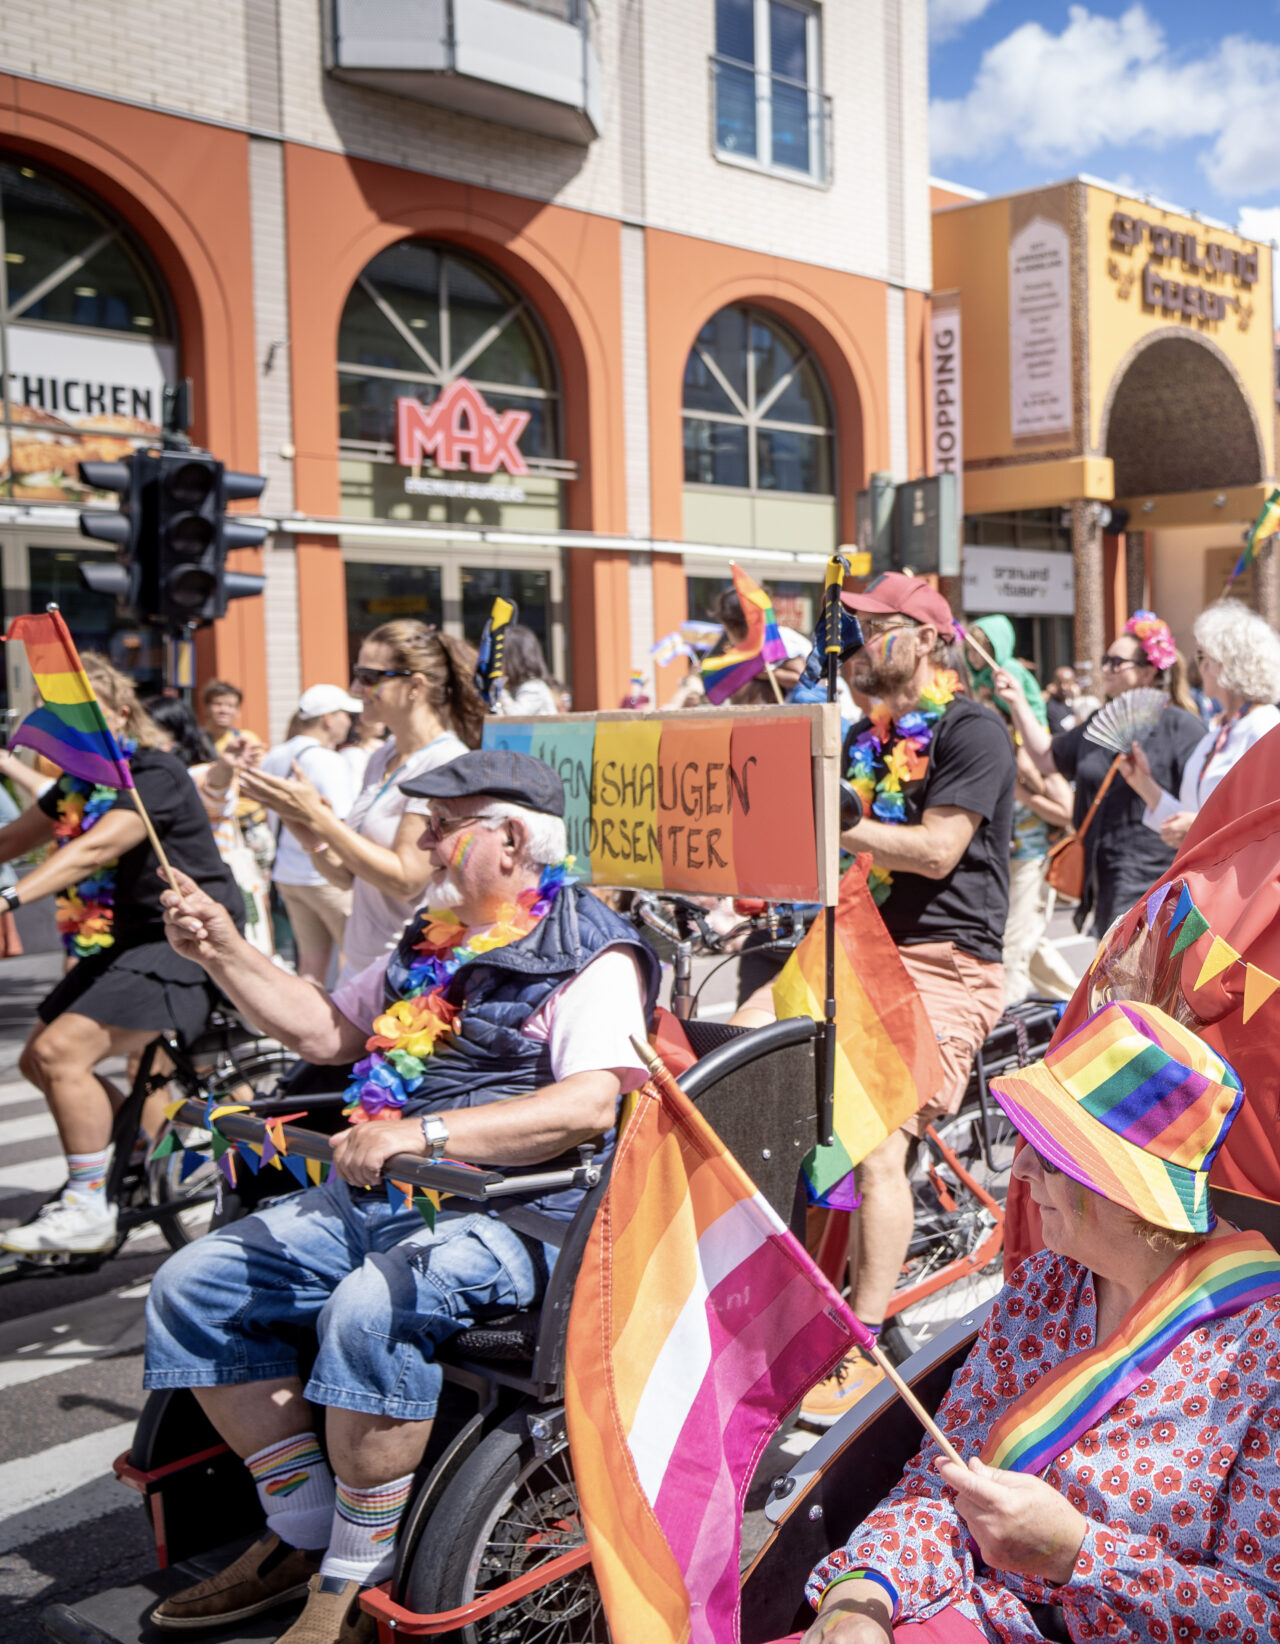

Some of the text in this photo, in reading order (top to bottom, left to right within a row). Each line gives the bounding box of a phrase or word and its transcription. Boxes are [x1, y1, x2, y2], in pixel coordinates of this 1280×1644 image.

[396, 377, 532, 476] MAX
[935, 328, 956, 475] HOPPING
[566, 816, 729, 870] IORSENTER
